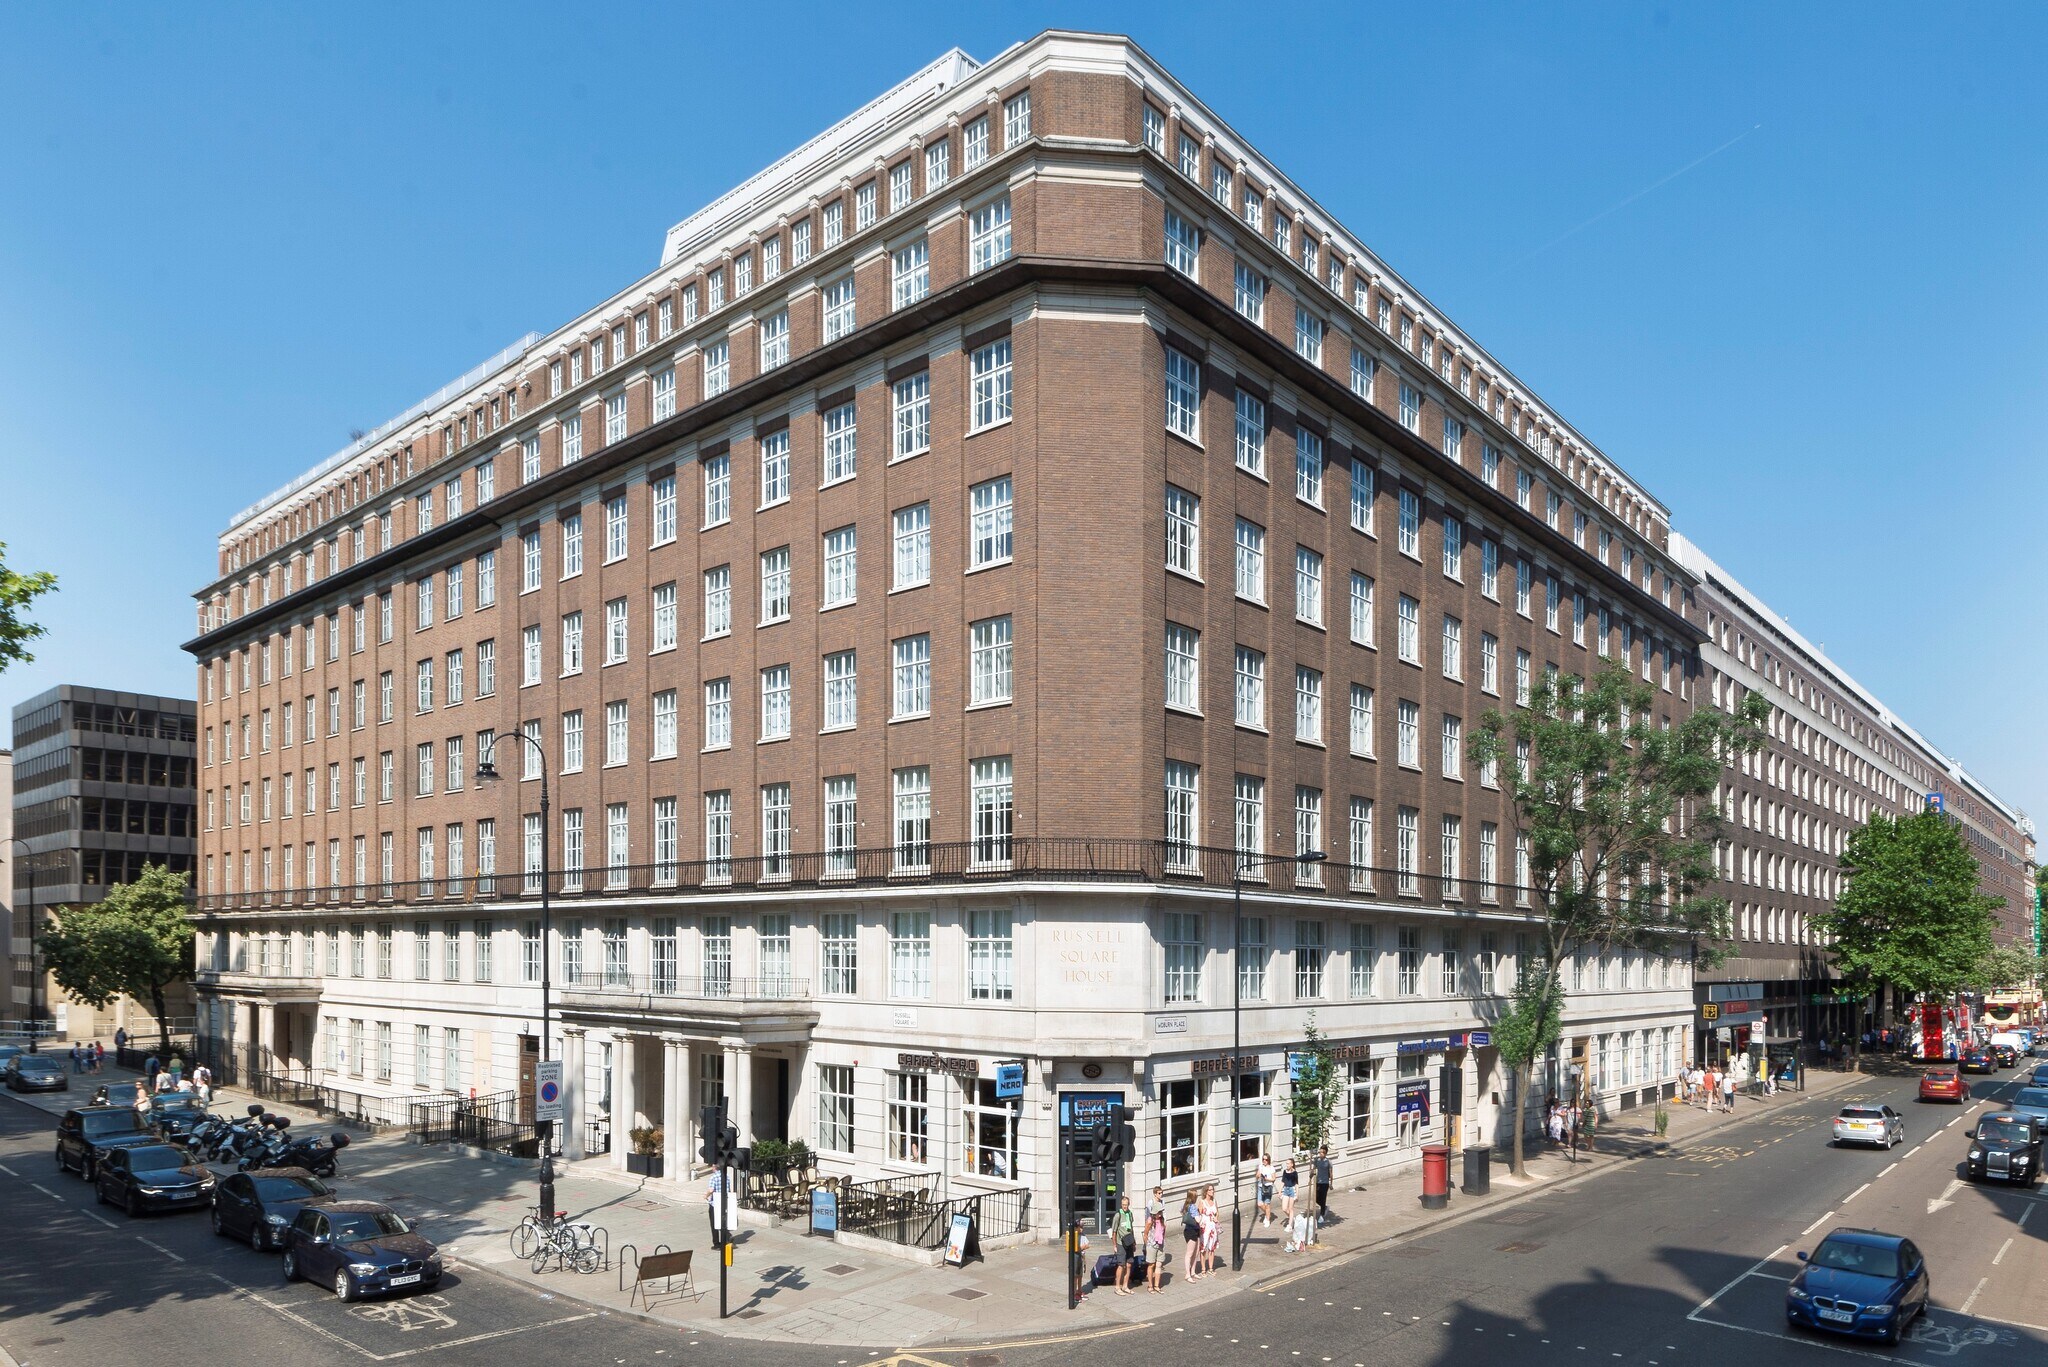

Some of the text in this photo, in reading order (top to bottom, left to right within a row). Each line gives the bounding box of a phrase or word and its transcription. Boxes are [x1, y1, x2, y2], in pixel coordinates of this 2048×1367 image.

[1052, 929, 1125, 943] RUSSELL
[1060, 950, 1119, 963] SQUARE
[1065, 970, 1114, 983] HOUSE
[939, 1056, 979, 1073] NERO
[1000, 1080, 1021, 1091] NERO
[815, 1208, 835, 1217] NERO
